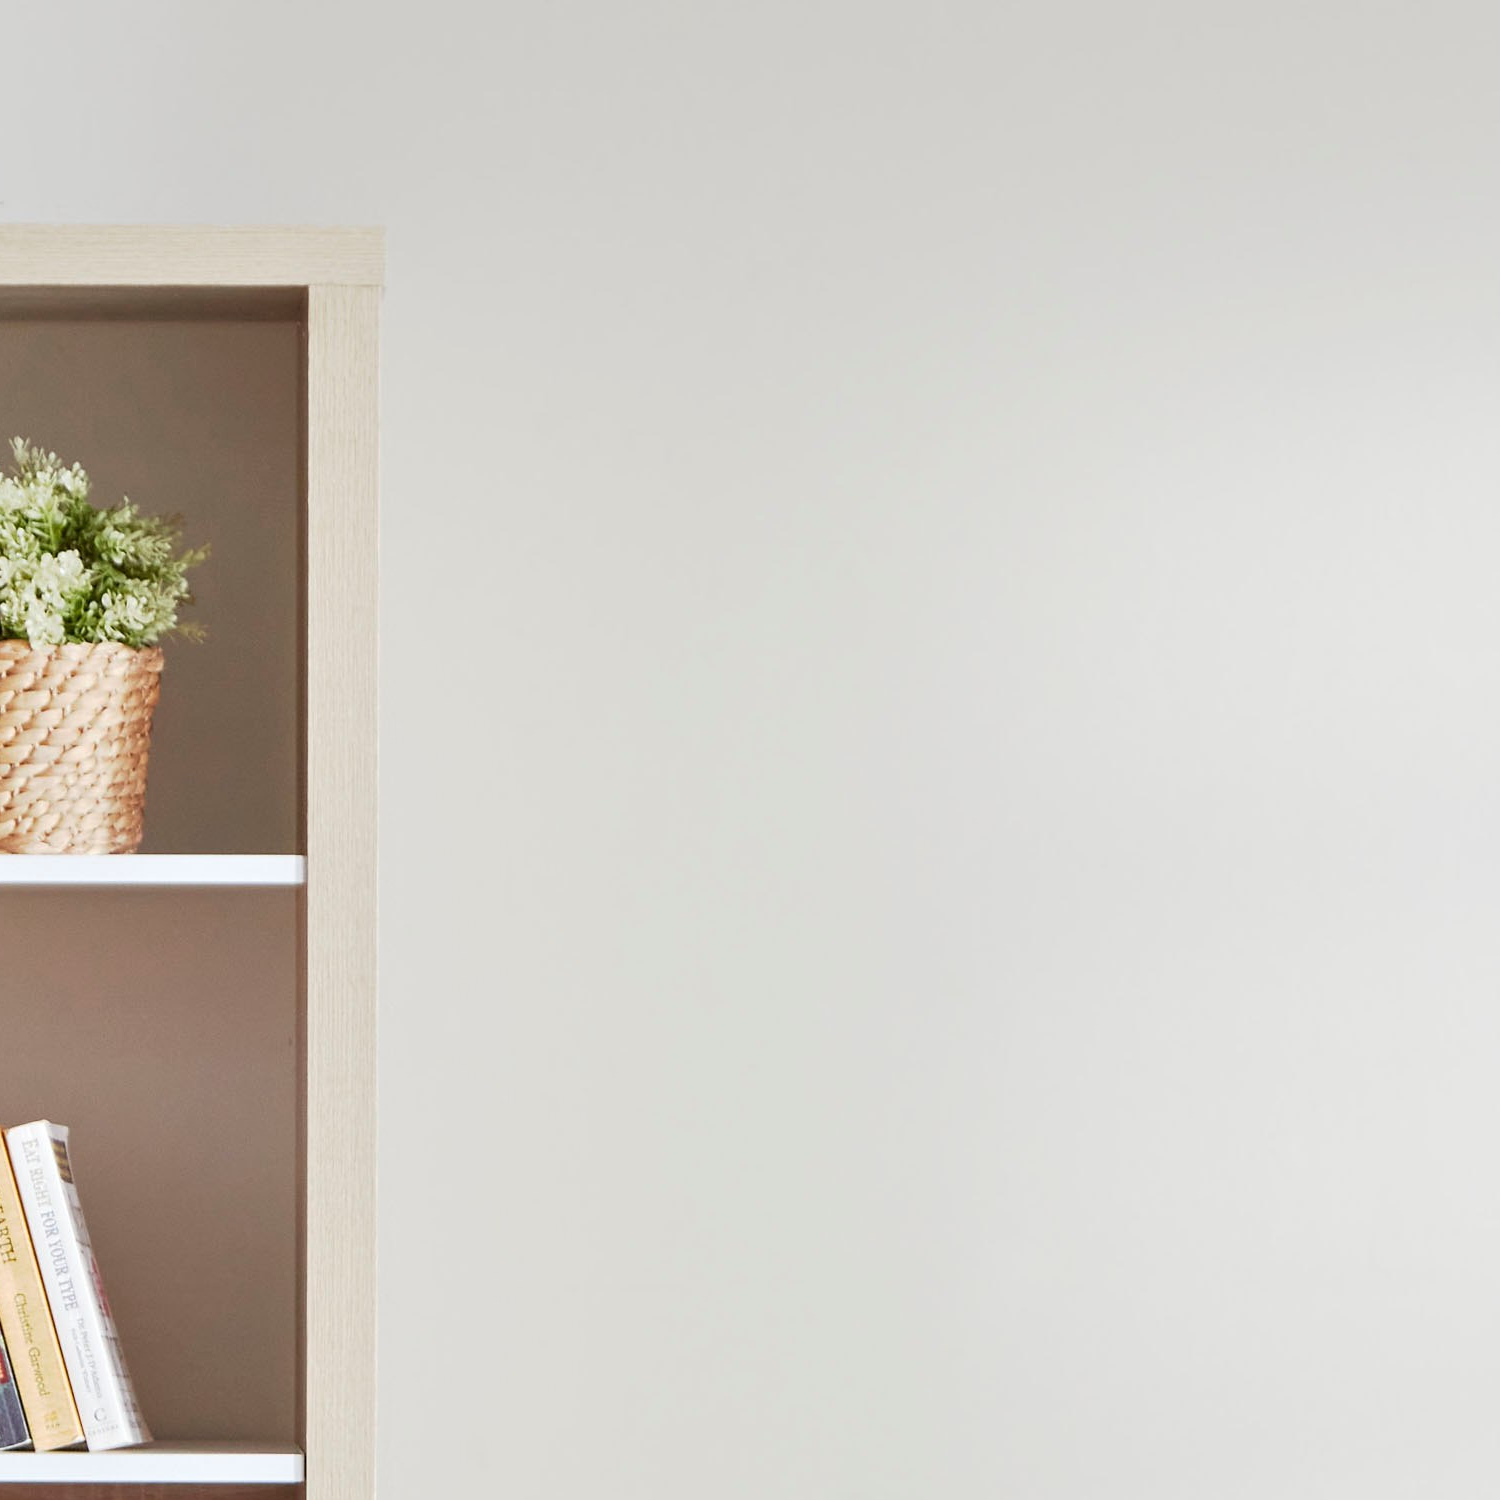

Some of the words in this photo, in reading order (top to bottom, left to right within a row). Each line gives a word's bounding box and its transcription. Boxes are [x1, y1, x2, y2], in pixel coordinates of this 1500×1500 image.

[22, 1138, 41, 1164] EAT
[29, 1166, 51, 1208] RIGHT
[40, 1210, 58, 1238] FOR
[48, 1240, 68, 1276] YOUR
[58, 1278, 78, 1311] TYPE
[14, 1292, 33, 1344] Christine
[28, 1346, 48, 1396] Garwood
